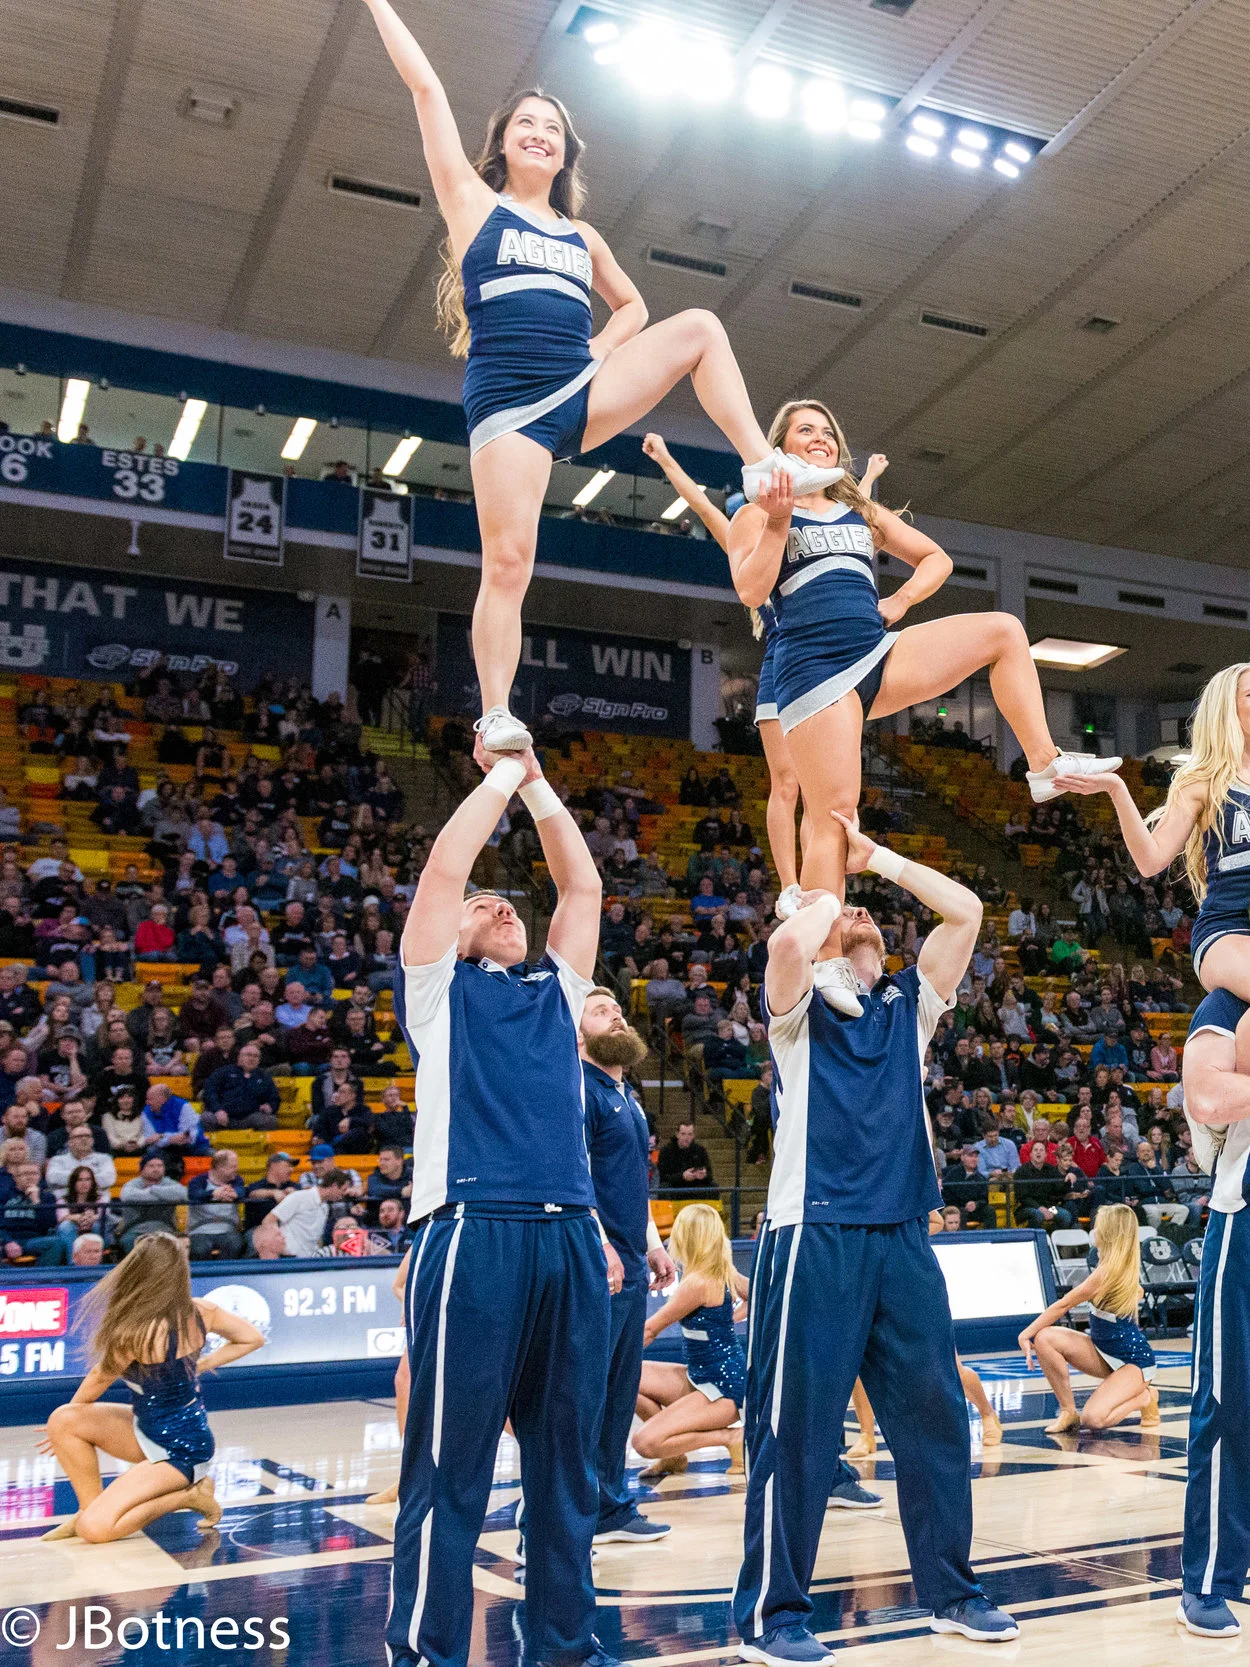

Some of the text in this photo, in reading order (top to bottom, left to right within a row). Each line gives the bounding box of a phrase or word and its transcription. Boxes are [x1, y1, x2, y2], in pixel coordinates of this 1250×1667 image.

[1, 453, 28, 482] 6
[102, 449, 180, 477] ESTES
[112, 469, 166, 502] 33
[237, 511, 273, 535] 24
[371, 531, 400, 551] 31
[0, 571, 245, 633] THAT WE
[326, 602, 341, 620] A
[591, 644, 672, 682] WIN
[700, 650, 714, 665] B
[283, 1284, 377, 1317] 92.3 FM
[24, 1340, 66, 1374] FM
